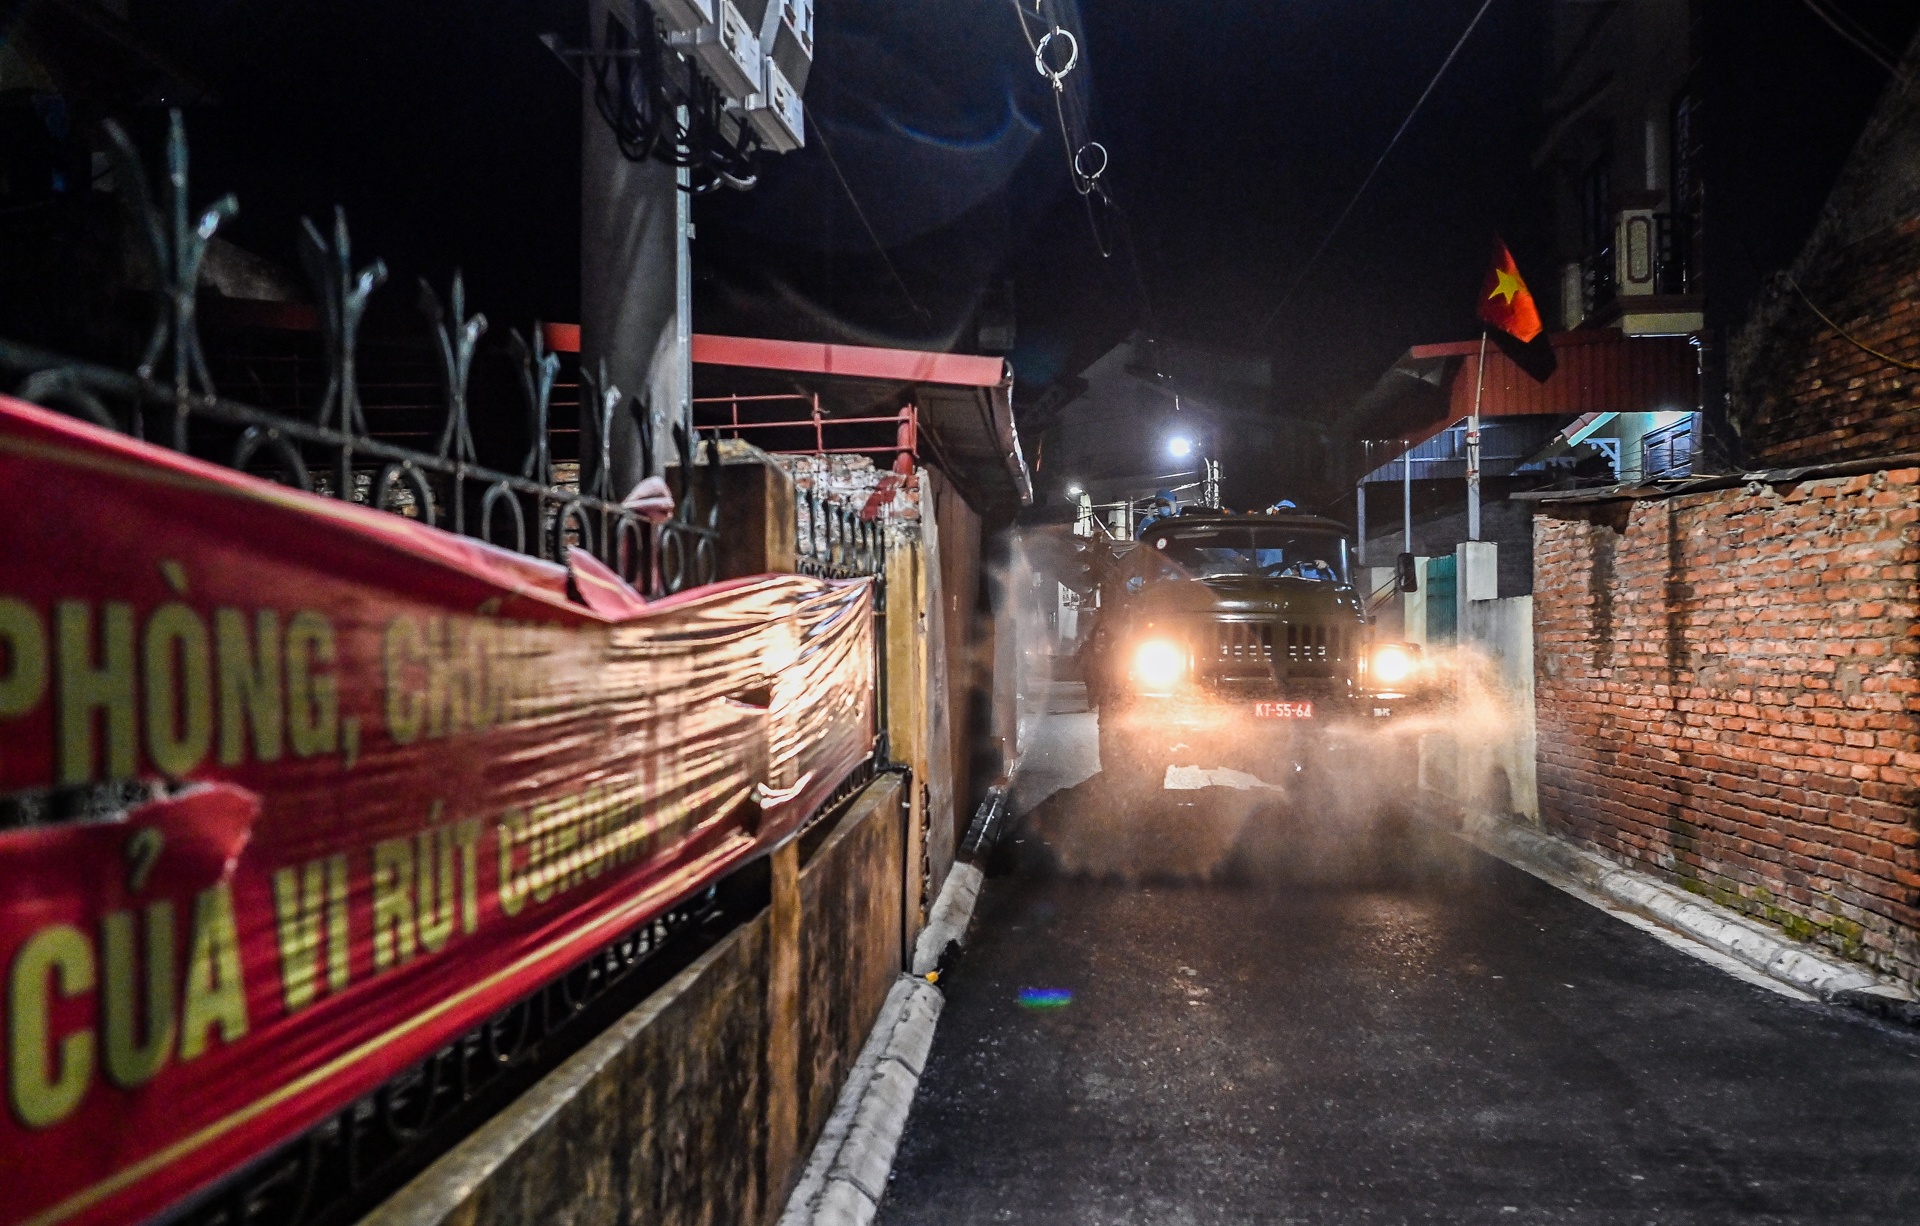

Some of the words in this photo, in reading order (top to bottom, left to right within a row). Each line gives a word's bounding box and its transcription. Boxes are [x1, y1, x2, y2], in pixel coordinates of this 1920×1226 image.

[1255, 702, 1312, 718] KT-55-64
[10, 827, 250, 1129] CỦA
[272, 852, 352, 1012] VI
[372, 799, 481, 976] RÚT
